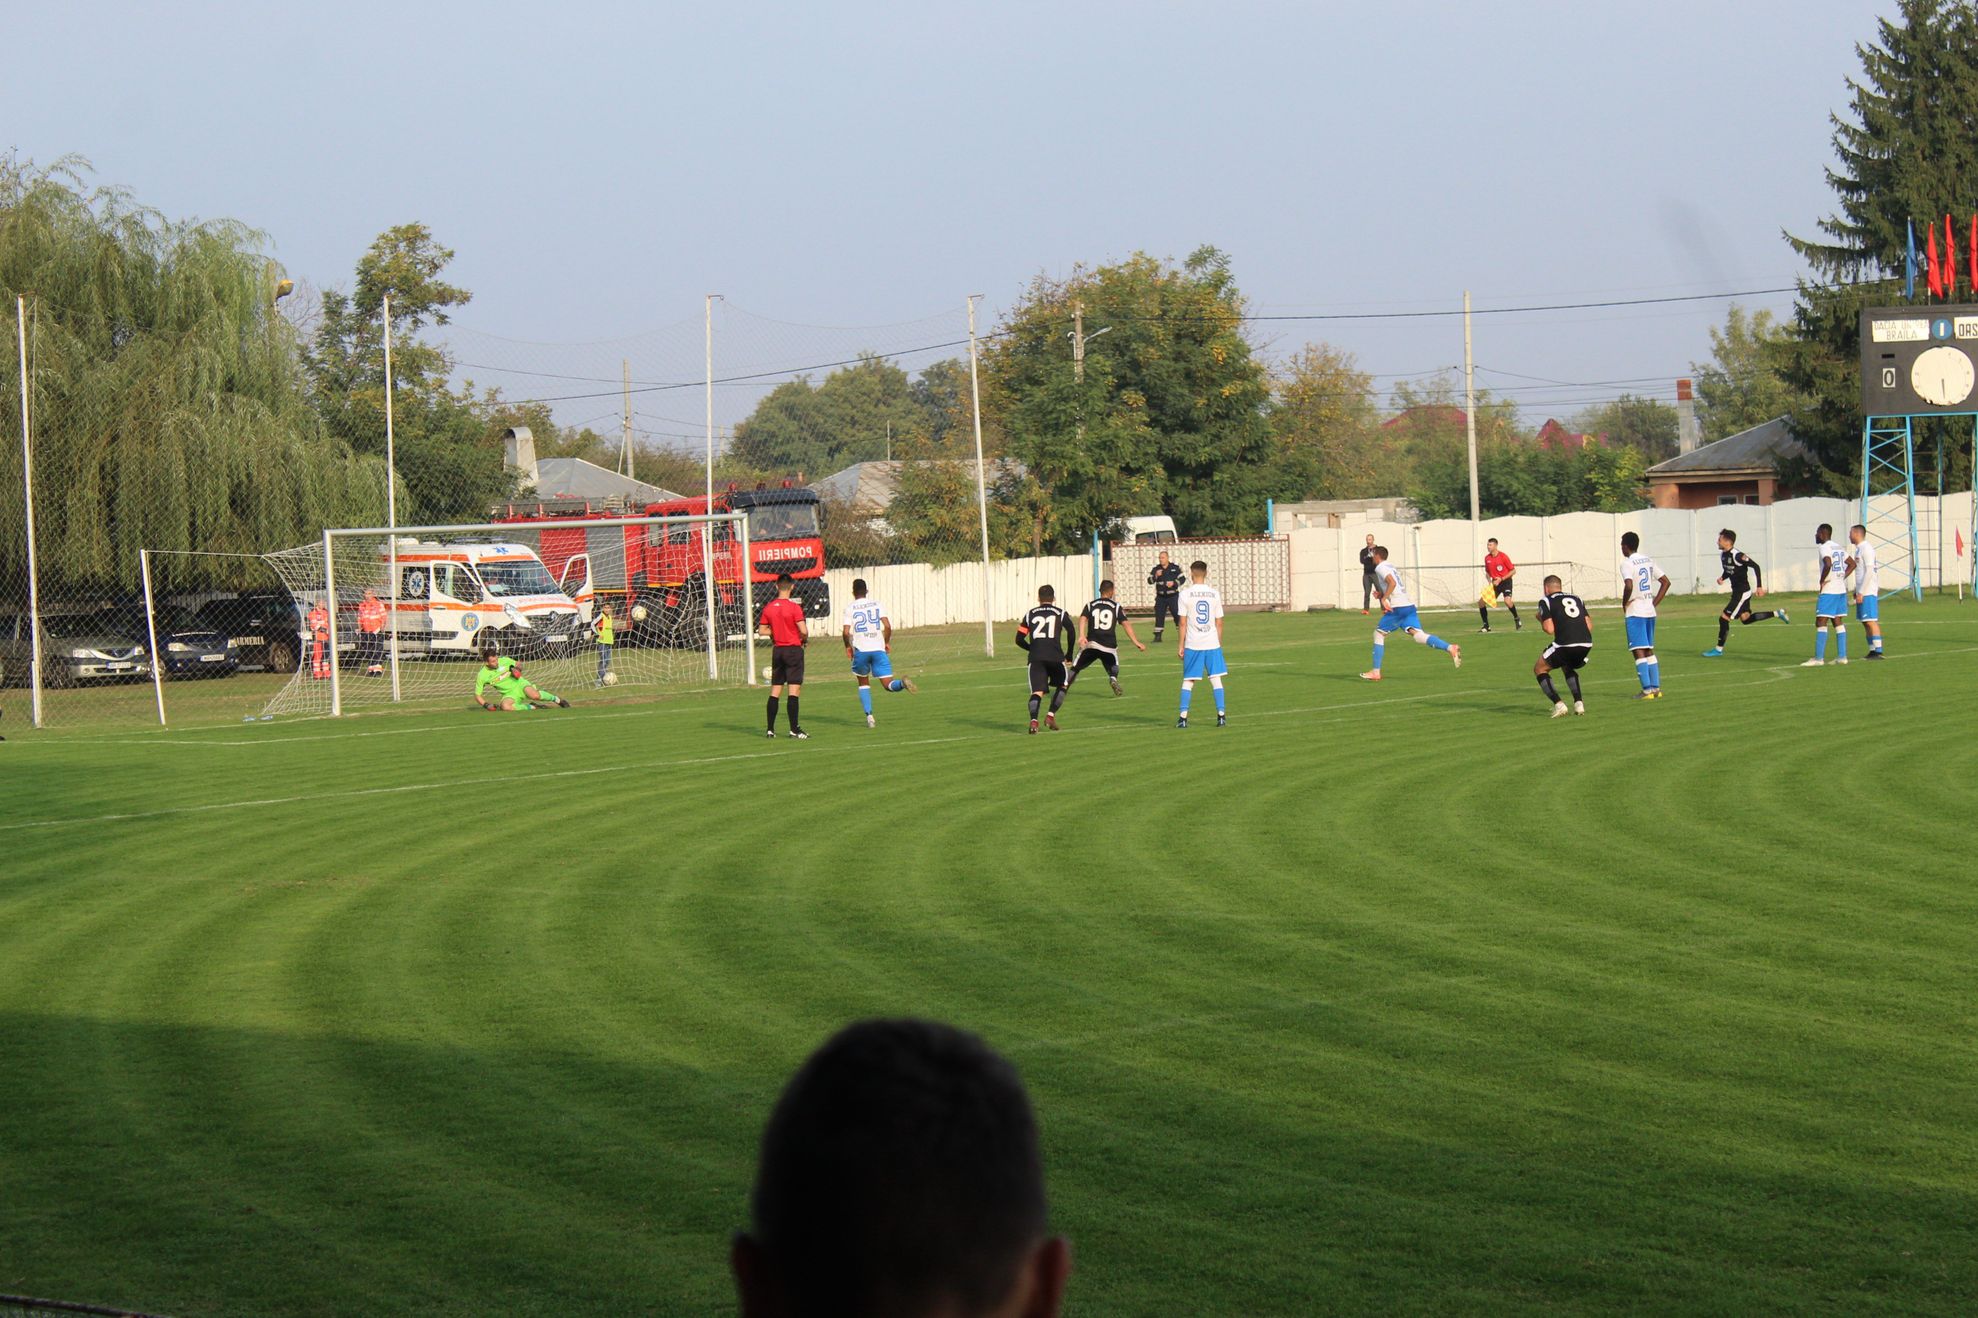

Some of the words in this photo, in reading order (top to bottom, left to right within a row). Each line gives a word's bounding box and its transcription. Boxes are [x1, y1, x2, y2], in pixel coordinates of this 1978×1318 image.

[1886, 330, 1918, 340] BRAILA
[1196, 600, 1210, 624] 9
[1562, 597, 1580, 618] 8
[853, 608, 881, 632] 24
[1031, 615, 1056, 639] 21
[1092, 609, 1113, 630] 19
